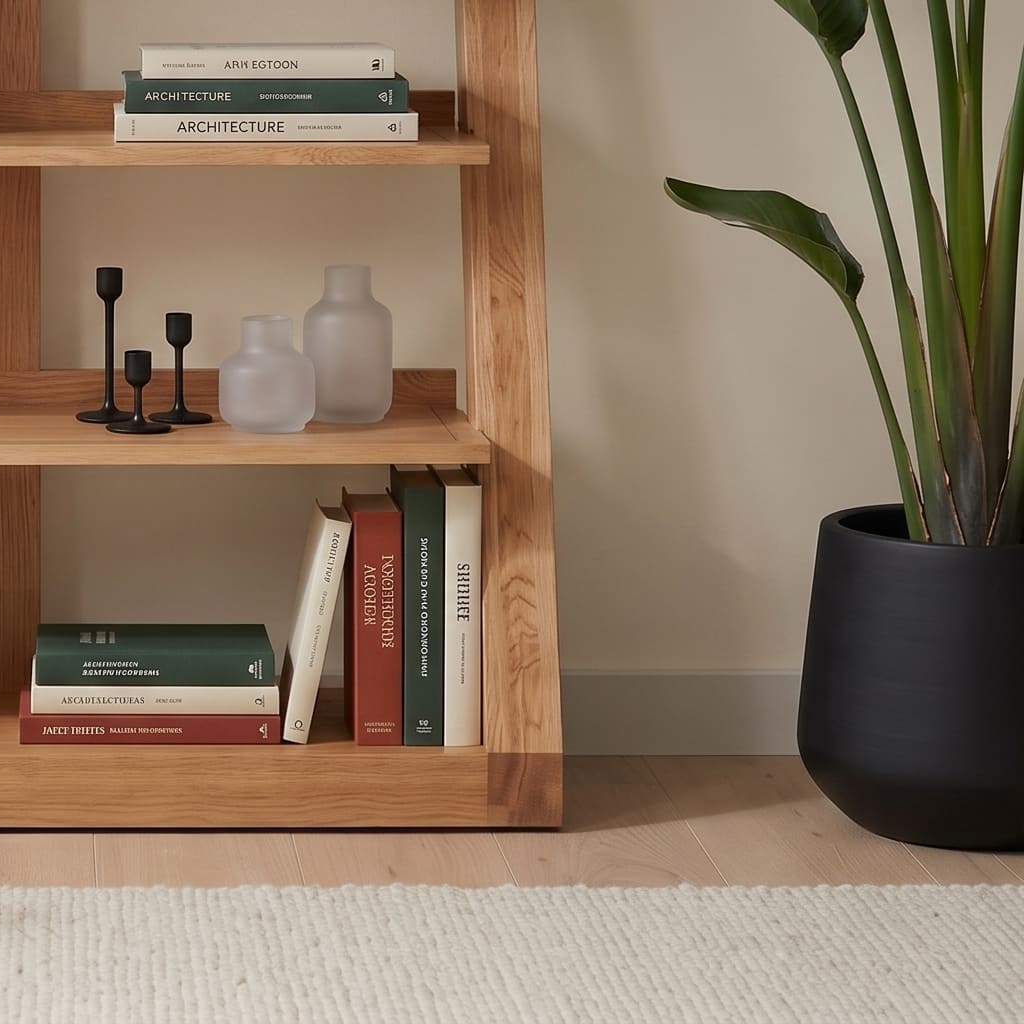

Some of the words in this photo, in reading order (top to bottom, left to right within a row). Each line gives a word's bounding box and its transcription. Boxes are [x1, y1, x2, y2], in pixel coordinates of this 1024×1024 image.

[252, 60, 298, 70] EGTOON
[144, 91, 232, 102] ARCHITECTURE
[177, 121, 285, 133] ARCHITECTURE
